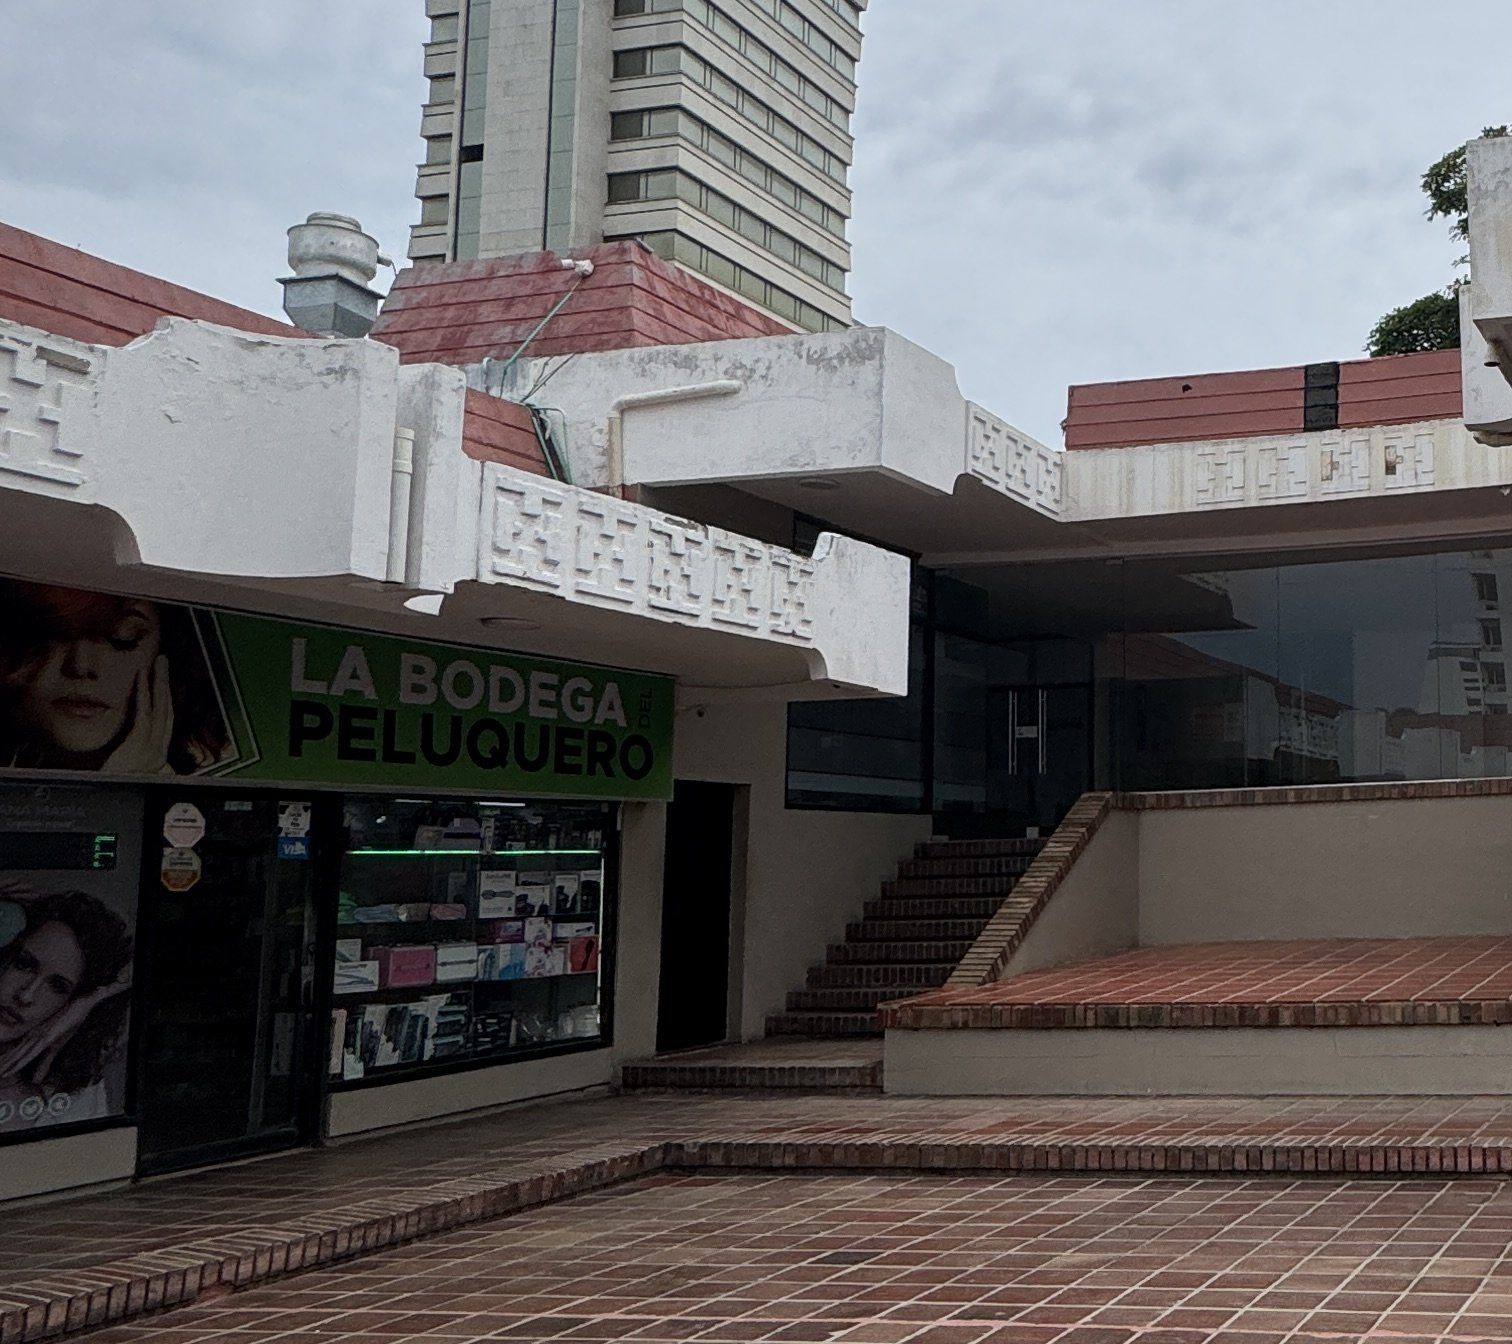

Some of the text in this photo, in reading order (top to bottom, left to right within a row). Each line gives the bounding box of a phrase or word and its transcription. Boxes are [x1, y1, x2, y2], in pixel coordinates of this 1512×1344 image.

[290, 637, 628, 728] LA BODEGA
[637, 687, 654, 730] DEL
[288, 699, 655, 780] PELUQUERO
